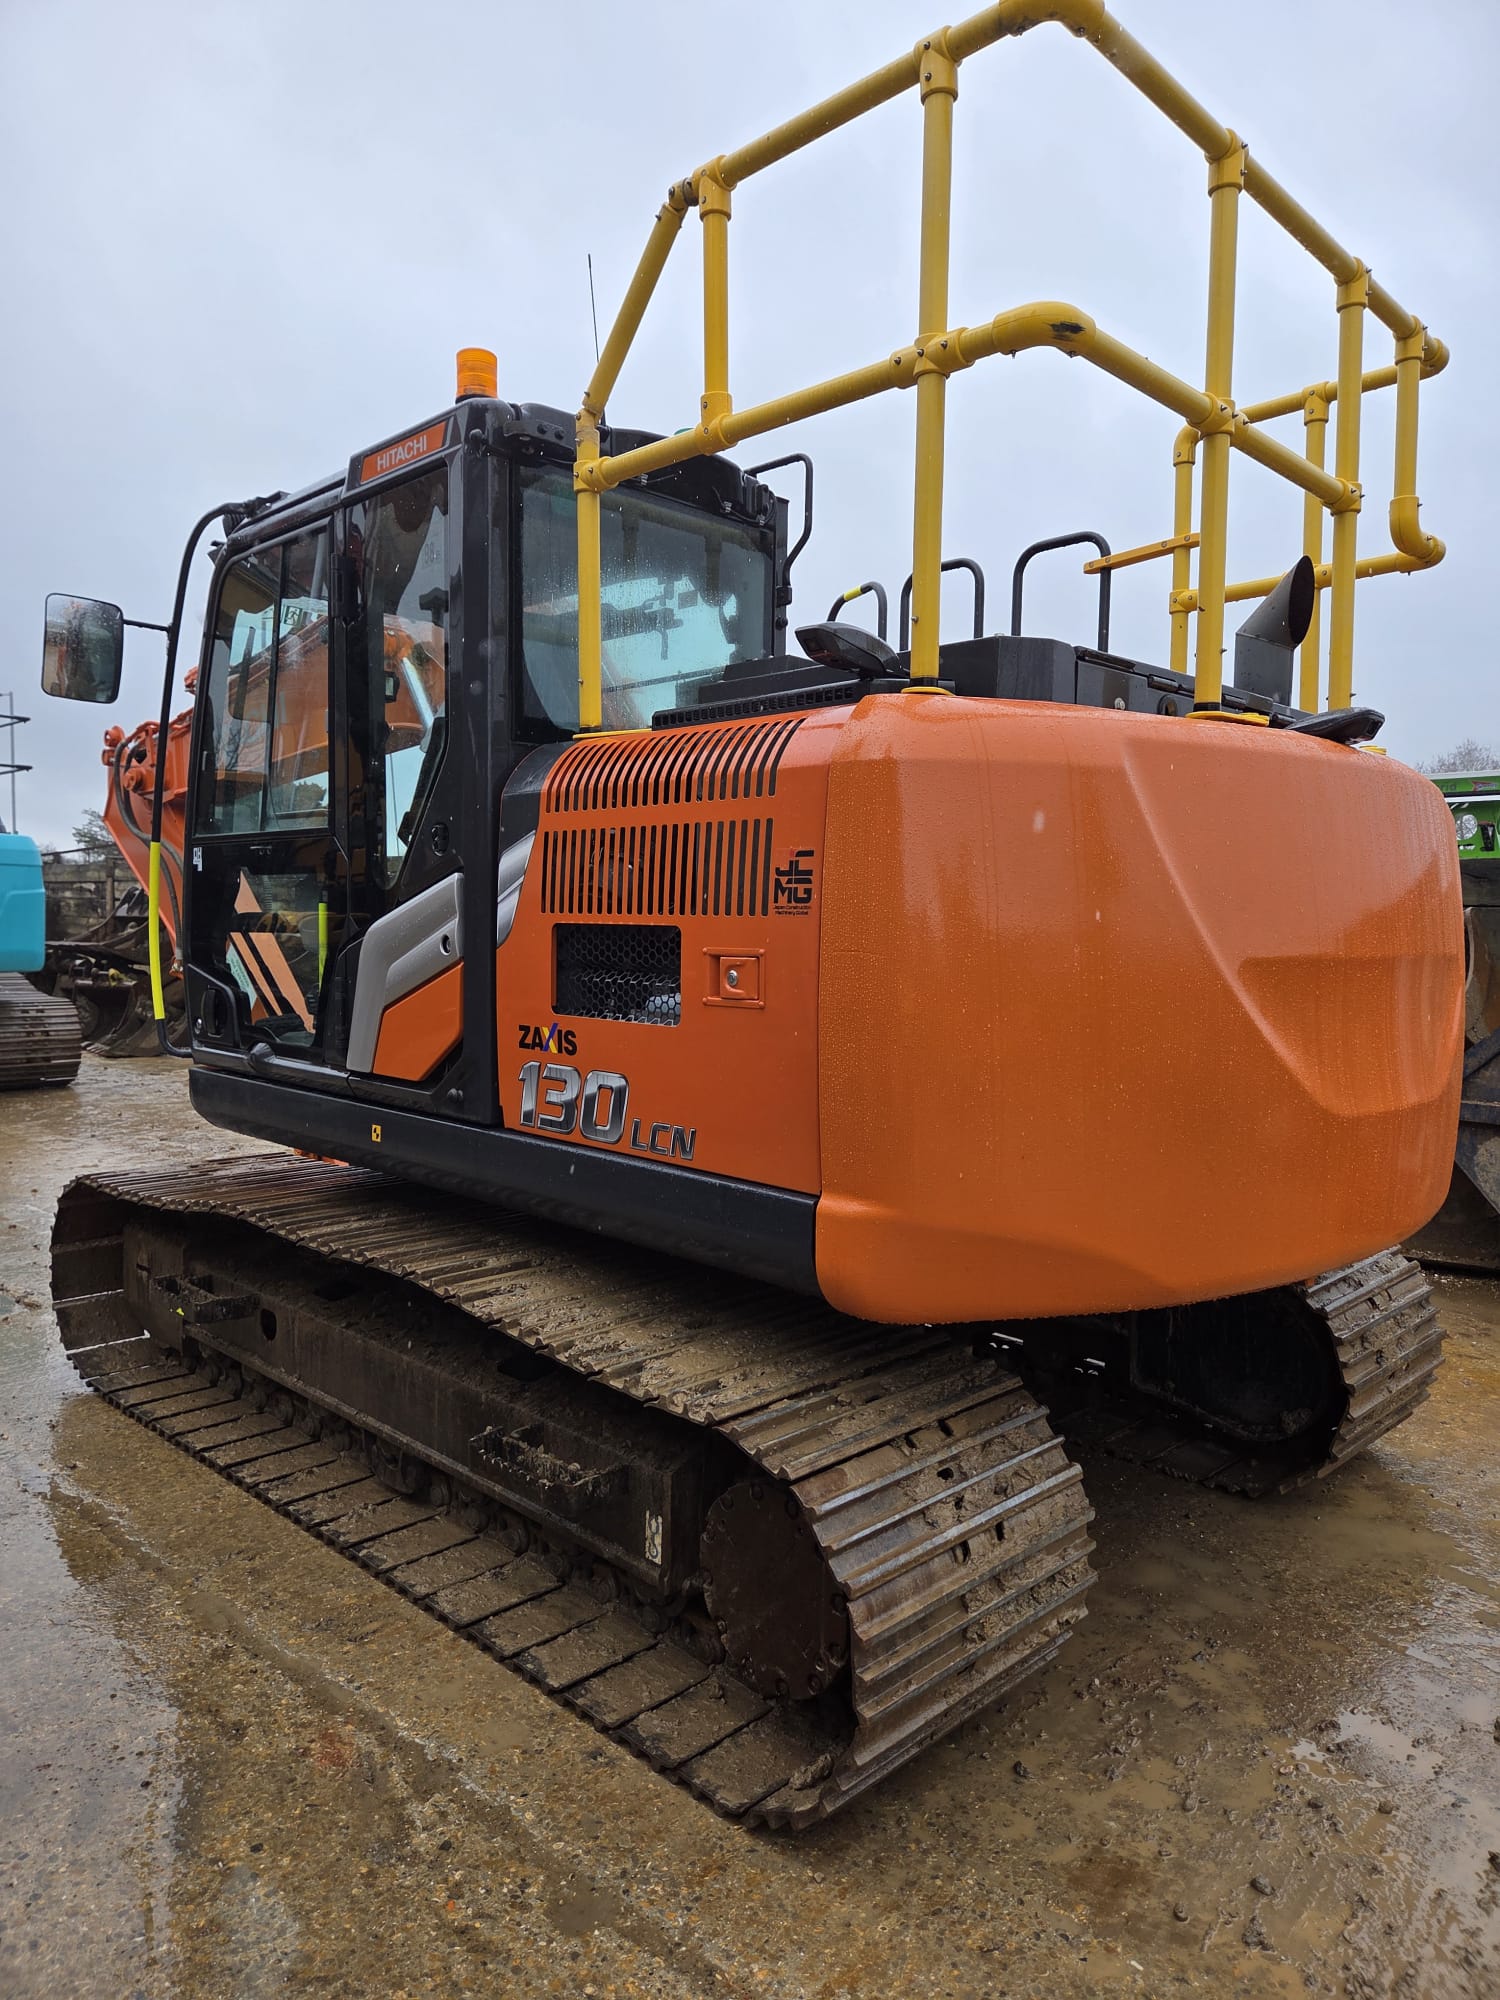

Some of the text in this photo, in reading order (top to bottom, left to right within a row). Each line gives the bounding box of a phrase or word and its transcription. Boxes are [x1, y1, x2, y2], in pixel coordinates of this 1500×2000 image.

[377, 435, 427, 472] HITACHI
[518, 1022, 577, 1056] ZAXIS
[518, 1060, 696, 1160] 130 LCN
